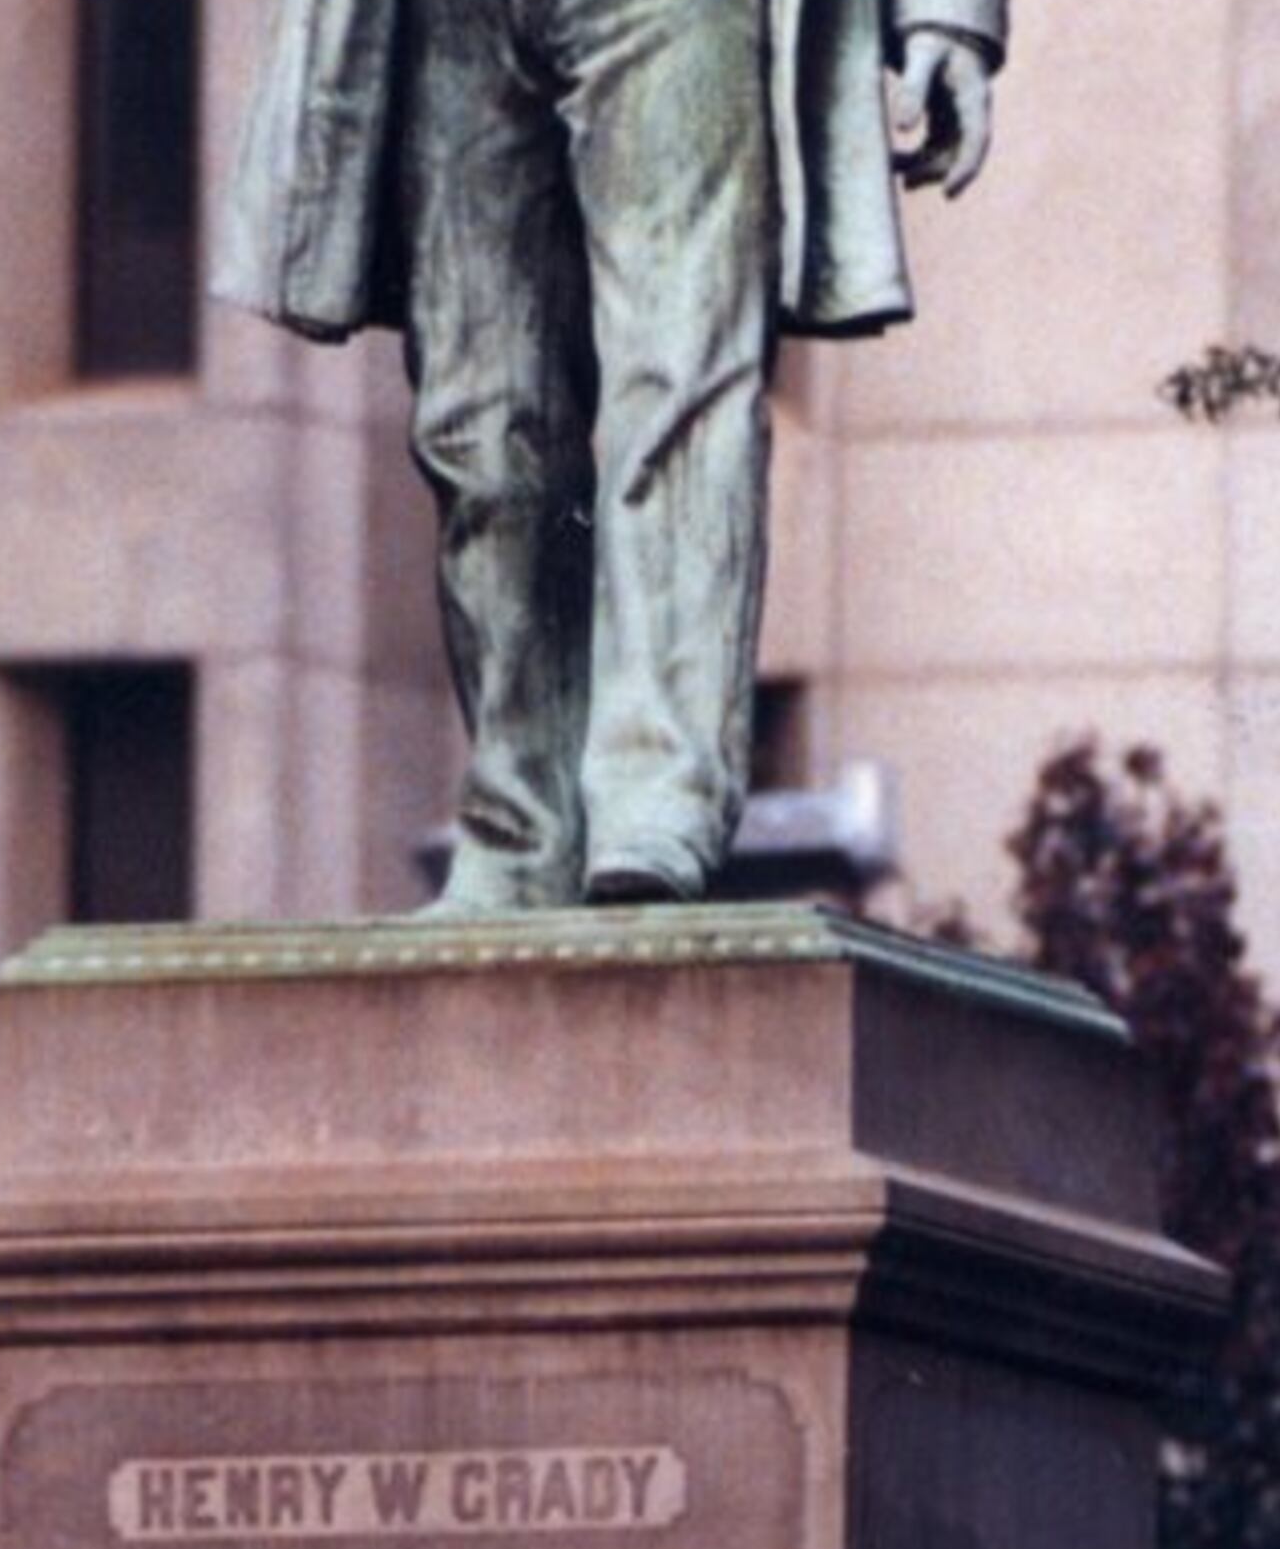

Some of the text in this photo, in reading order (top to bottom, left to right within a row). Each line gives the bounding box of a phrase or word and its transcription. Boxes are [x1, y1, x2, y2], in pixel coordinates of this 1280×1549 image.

[138, 1455, 660, 1530] HENRY W GRADY
